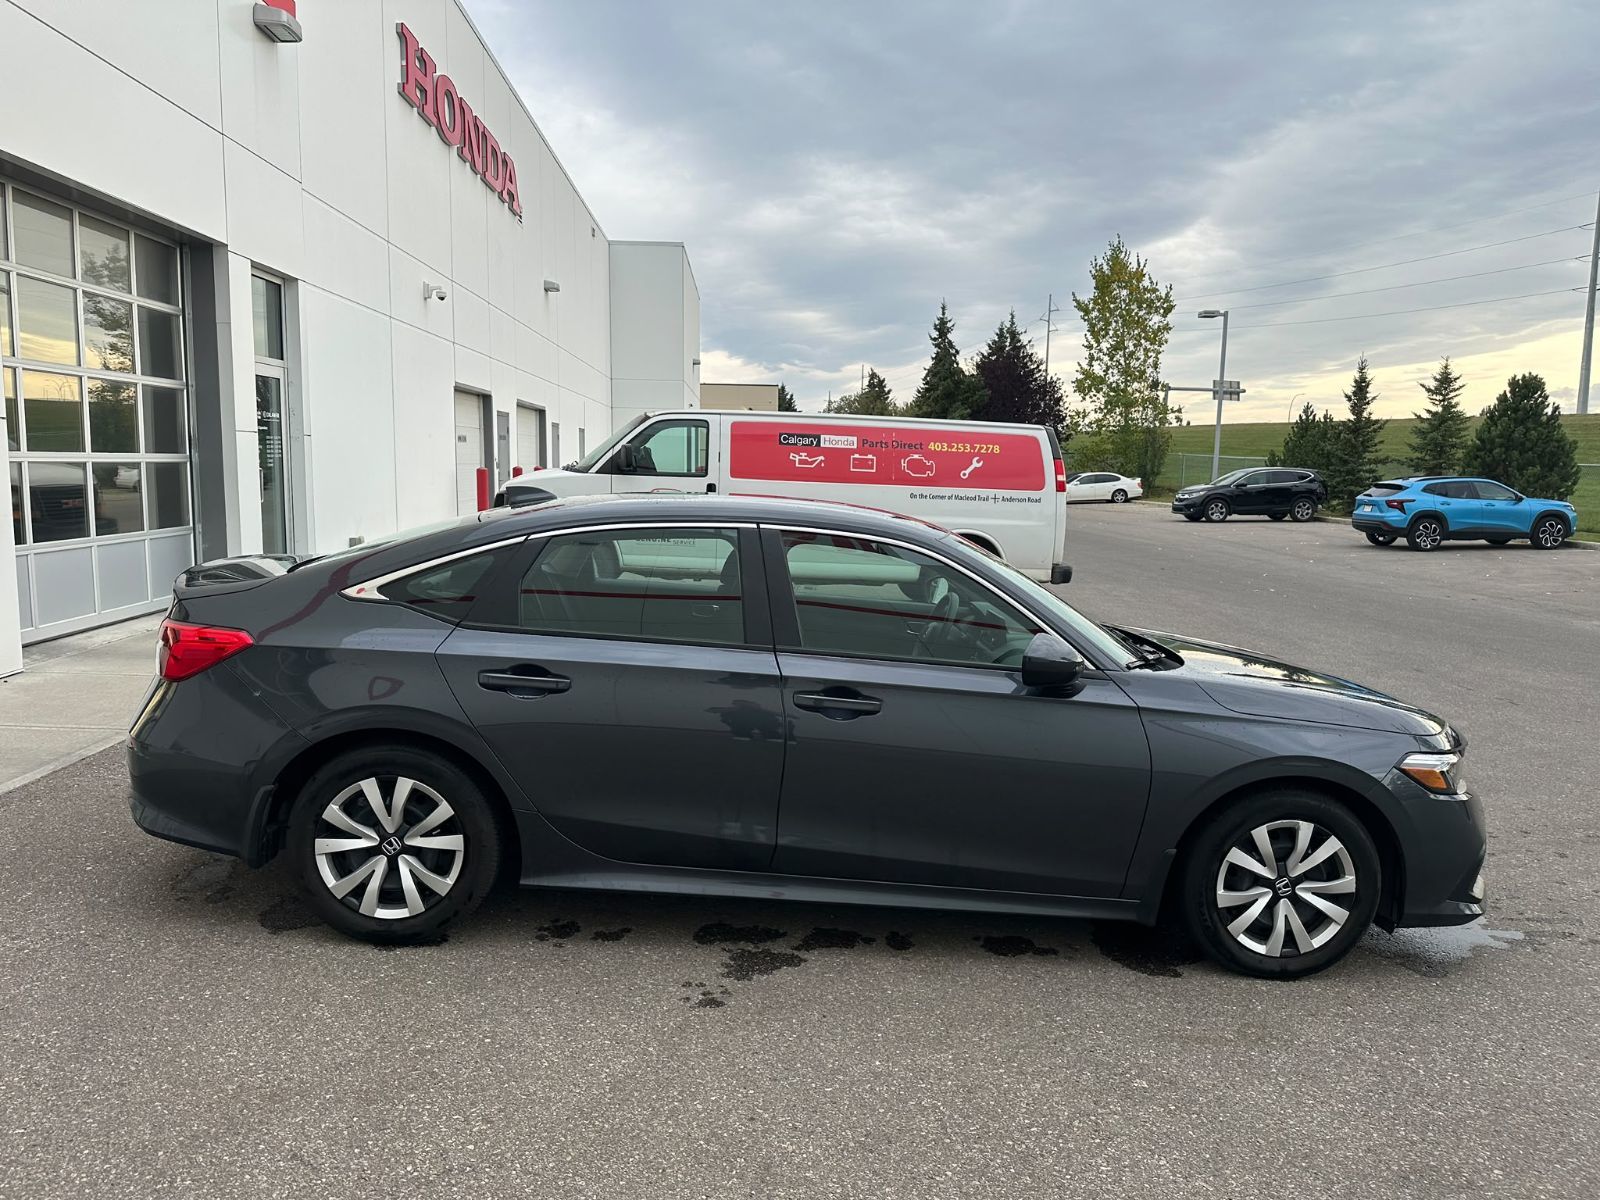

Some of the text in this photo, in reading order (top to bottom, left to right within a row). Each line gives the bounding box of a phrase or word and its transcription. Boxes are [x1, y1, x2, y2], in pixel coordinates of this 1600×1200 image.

[396, 22, 522, 217] HONDA
[780, 434, 1001, 454] Calgary Honda Parts Direct 403.253.7278
[1001, 495, 1027, 503] Anderson
[1027, 496, 1042, 504] Road
